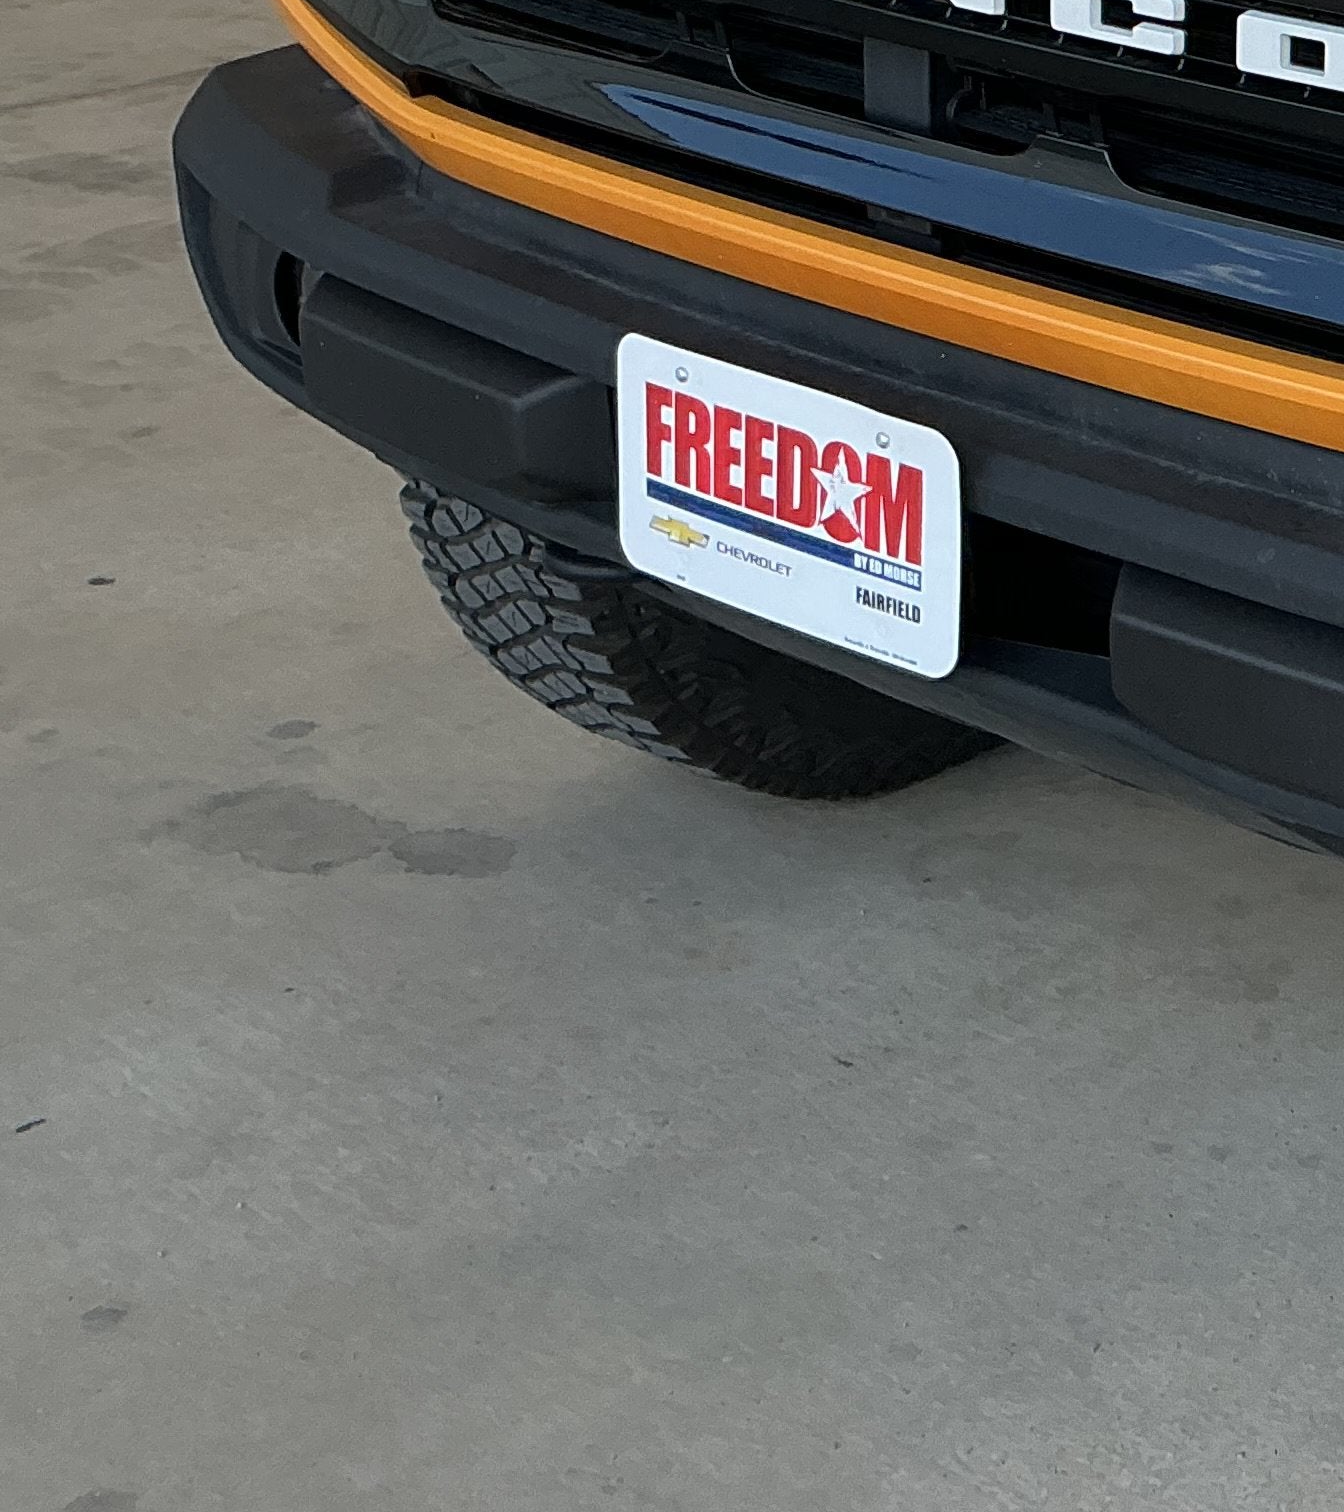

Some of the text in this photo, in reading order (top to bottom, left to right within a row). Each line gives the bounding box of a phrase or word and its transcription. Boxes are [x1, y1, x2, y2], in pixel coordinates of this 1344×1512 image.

[645, 380, 923, 566] FREEDOM
[716, 540, 792, 578] CHEVROLET
[853, 552, 921, 588] BY ED MORSE
[855, 585, 921, 625] FAIRFIELD
